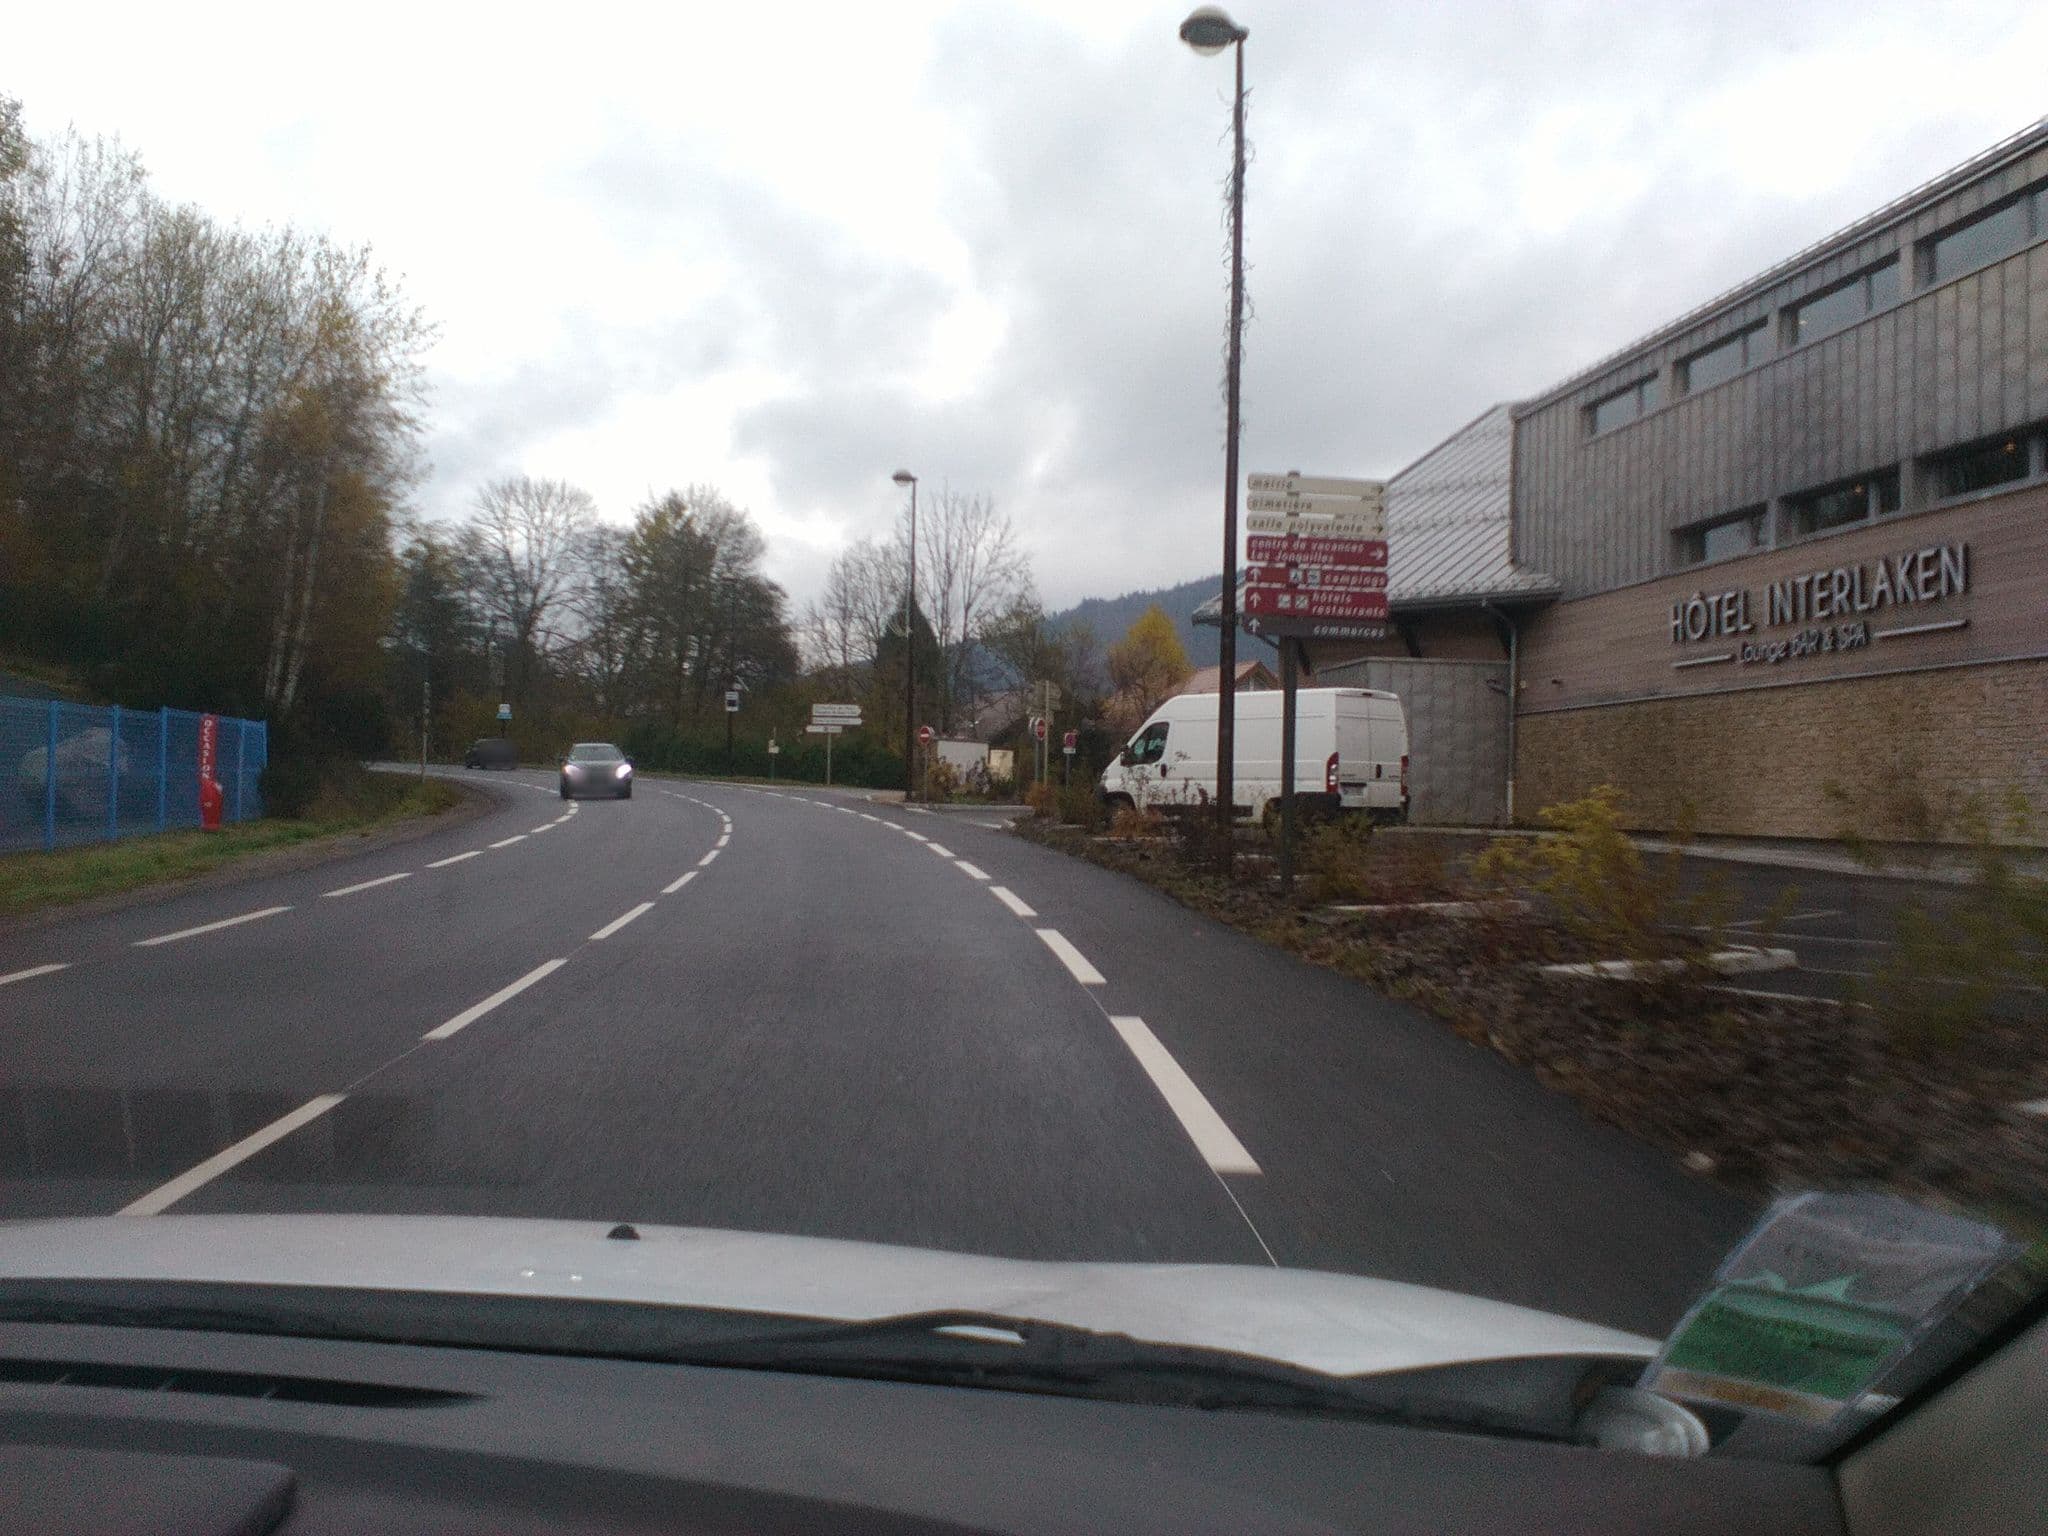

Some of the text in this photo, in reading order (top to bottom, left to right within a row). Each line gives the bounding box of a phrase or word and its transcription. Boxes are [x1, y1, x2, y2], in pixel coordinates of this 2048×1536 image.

[1252, 518, 1363, 532] salle polyvalente
[1250, 540, 1365, 552] centre de vacances
[1325, 575, 1385, 587] campings
[1312, 592, 1352, 603] hôtels
[1671, 545, 1968, 642] HÔTEL INTERLAKEN
[1312, 605, 1385, 616] restaurants
[1313, 626, 1385, 637] commerces
